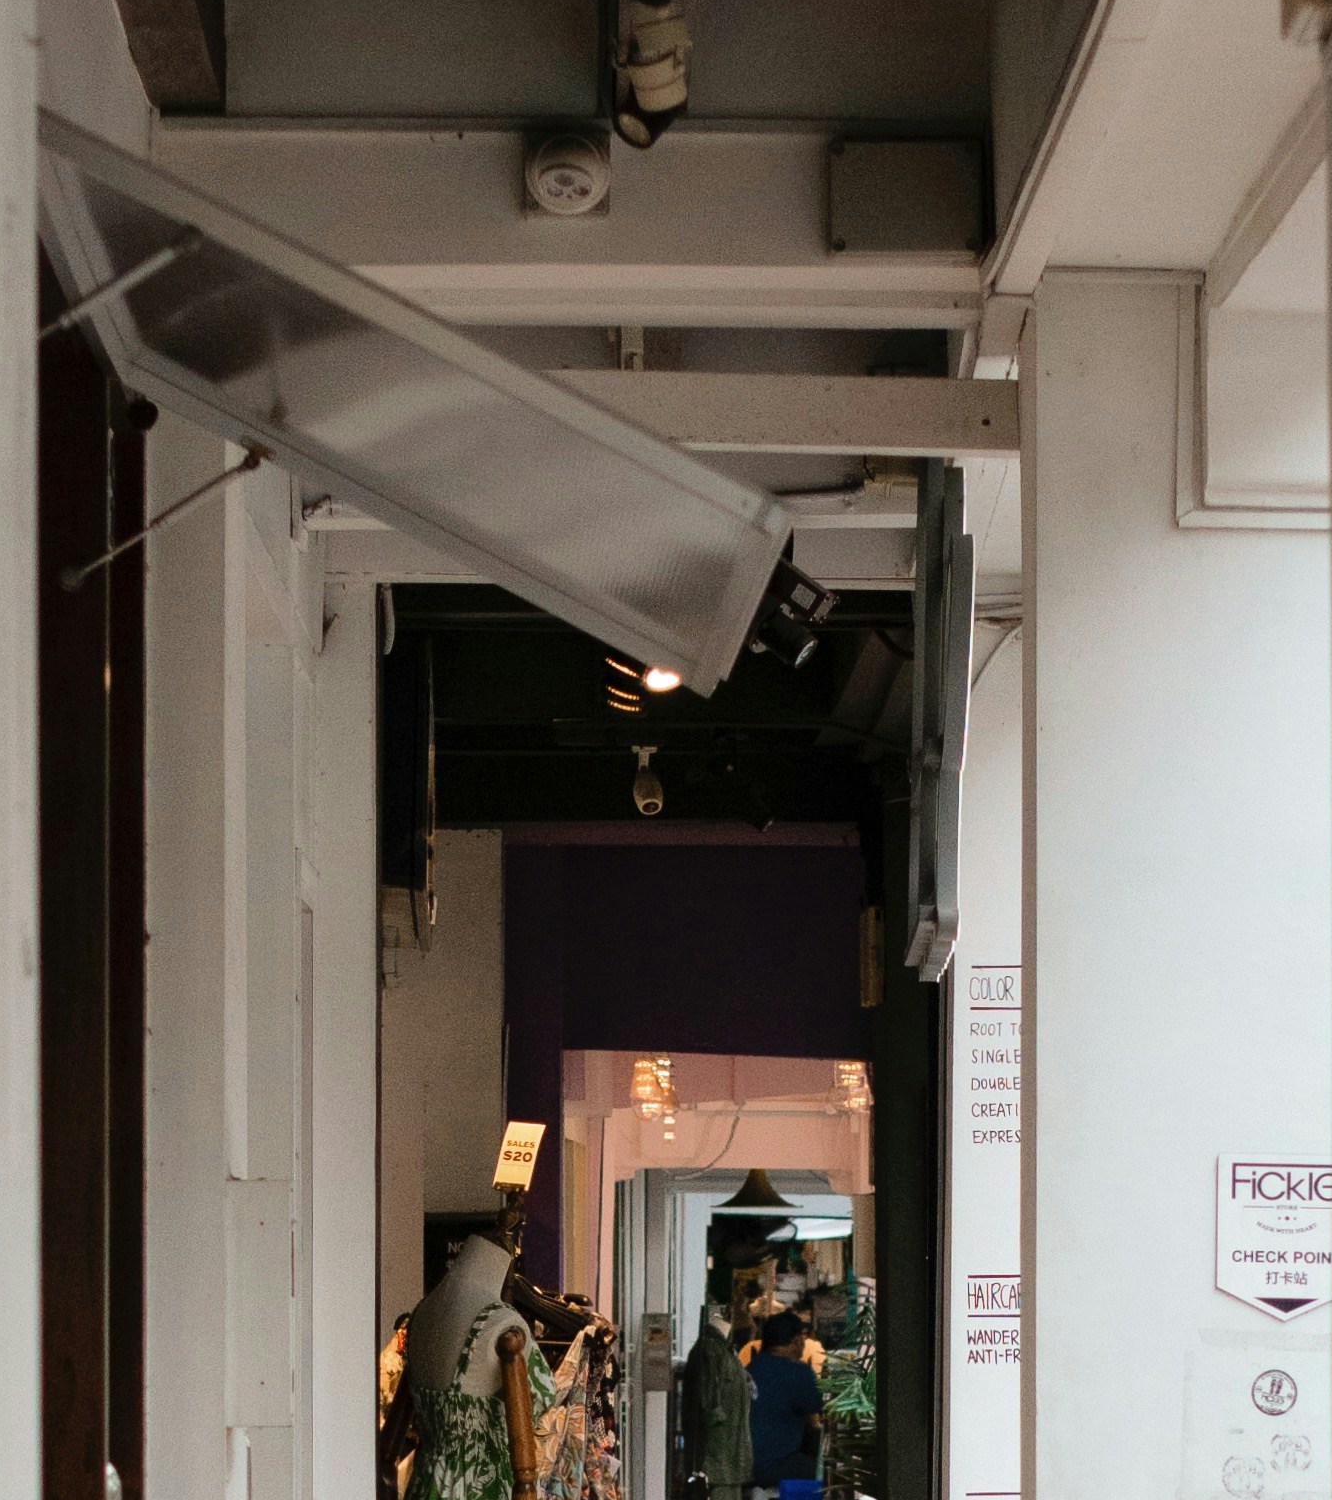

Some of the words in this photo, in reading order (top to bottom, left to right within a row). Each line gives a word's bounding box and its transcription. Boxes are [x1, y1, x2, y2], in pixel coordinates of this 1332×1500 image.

[969, 975, 1015, 1002] COLOR
[970, 1022, 1003, 1037] ROOT
[971, 1048, 1021, 1065] SINGLE
[971, 1076, 1021, 1091] DOUBLE
[971, 1102, 1020, 1118] CREATI
[506, 1139, 535, 1149] SALES
[1231, 1250, 1288, 1264] CHECK
[1265, 1270, 1308, 1286] 打卡站
[967, 1329, 1019, 1346] WANDER
[967, 1348, 1021, 1365] ANTI-FR
